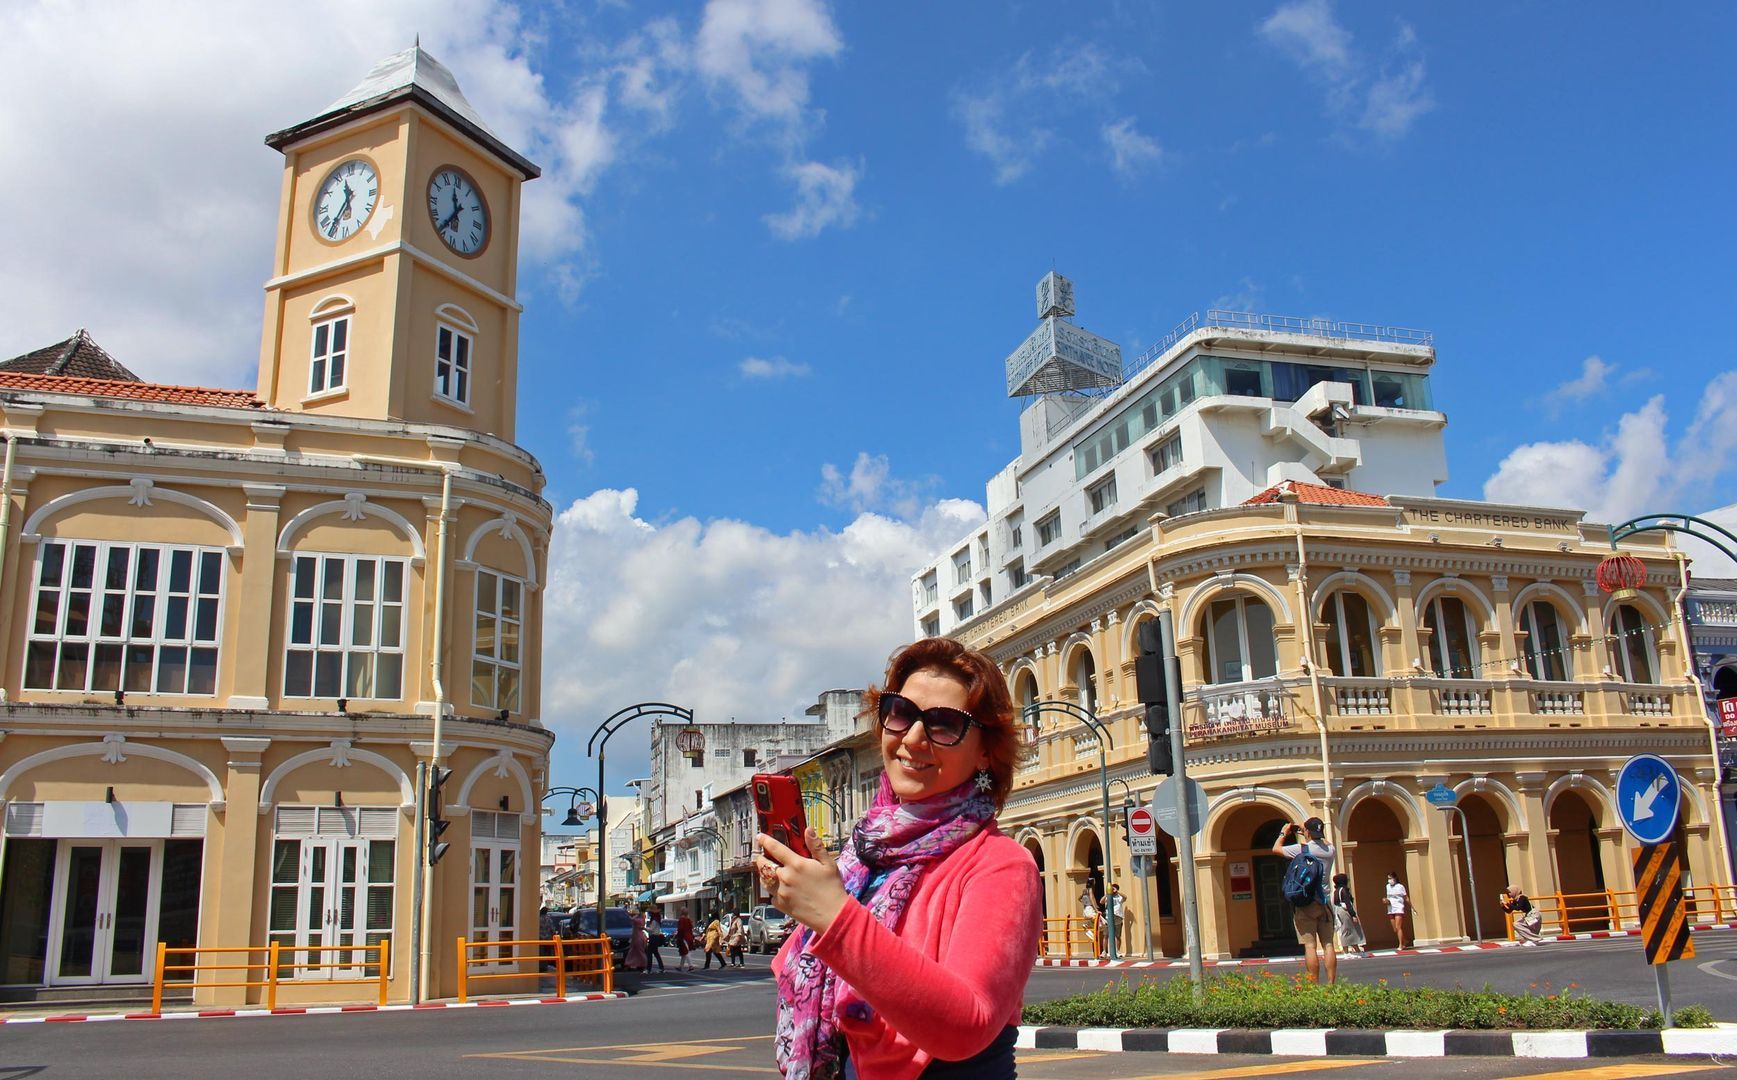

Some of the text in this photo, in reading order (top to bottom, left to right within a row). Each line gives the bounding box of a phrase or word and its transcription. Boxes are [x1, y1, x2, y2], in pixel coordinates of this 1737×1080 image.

[368, 188, 377, 197] III
[472, 219, 482, 231] III
[1409, 508, 1571, 531] THE CHARTERED BANK
[970, 610, 1008, 639] CHARTERED
[1010, 599, 1030, 617] BANK
[1255, 721, 1289, 730] MUSEUM
